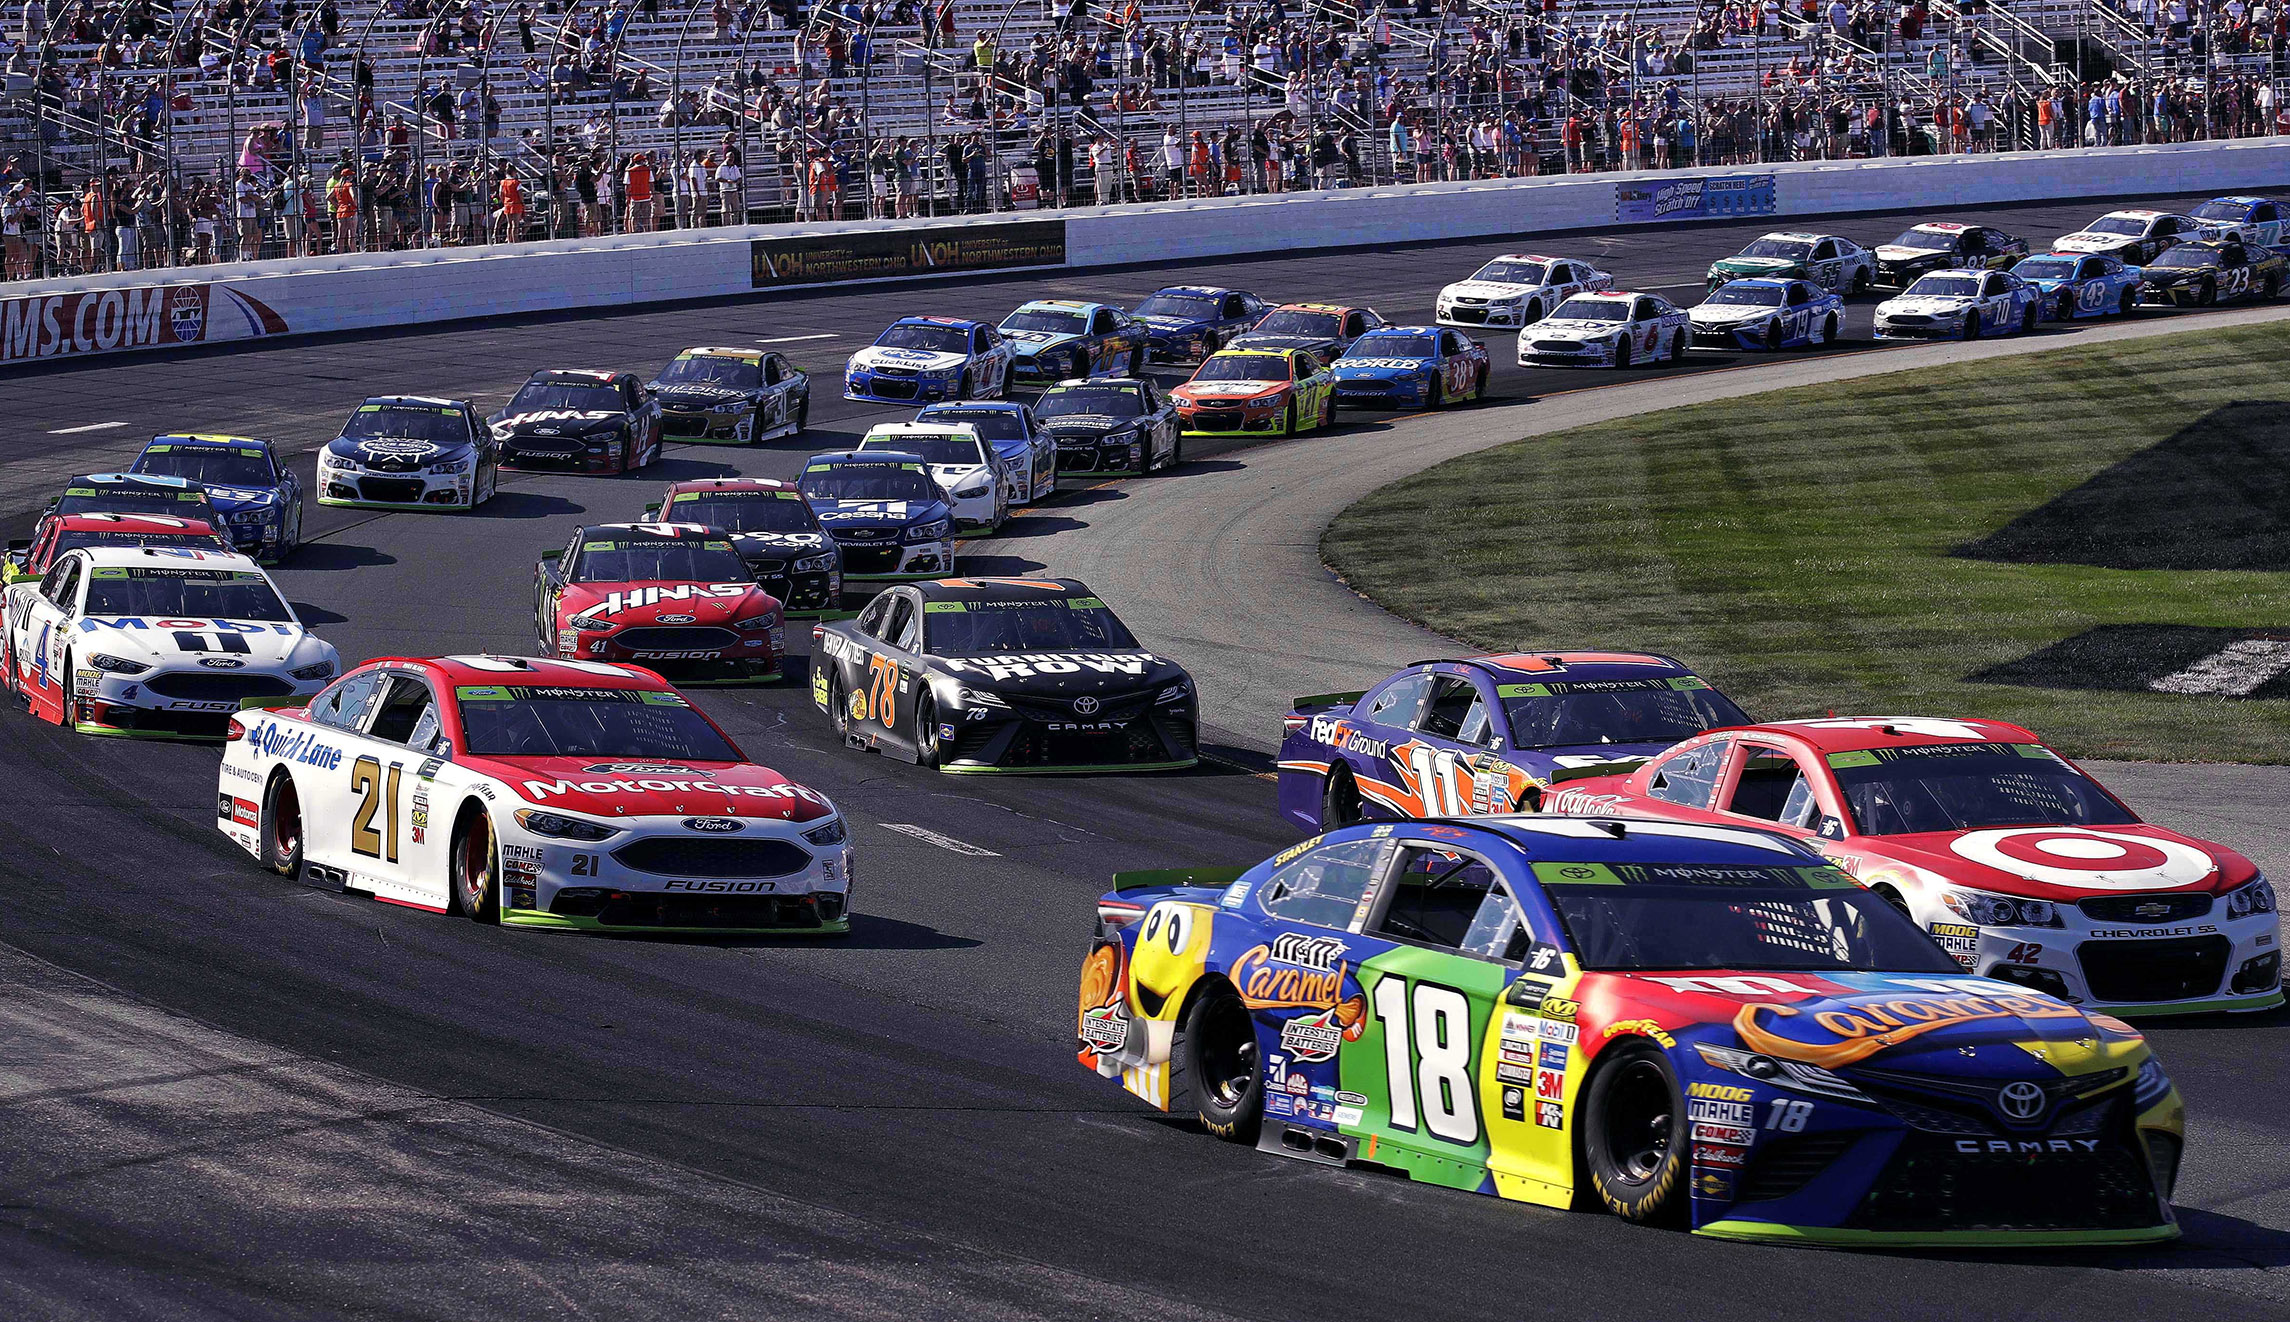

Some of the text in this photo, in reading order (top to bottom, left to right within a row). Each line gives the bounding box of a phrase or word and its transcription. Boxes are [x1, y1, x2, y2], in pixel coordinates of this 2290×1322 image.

[1656, 181, 1703, 202] High Speed
[1709, 181, 1731, 191] SCRATCH
[1732, 180, 1745, 190] HERE
[1655, 195, 1701, 216] Scratch Off
[911, 239, 959, 266] UNOH
[961, 244, 1062, 262] NORTHWESTERN OHIO
[962, 239, 1000, 249] UNIVERSITY
[754, 250, 803, 278] UNOH
[806, 250, 846, 260] UNIVERSITY
[806, 257, 906, 275] NORTHWESTERN OHIO
[2229, 266, 2250, 295] 23
[2086, 281, 2106, 308] 43
[1994, 298, 2011, 326] 10
[1645, 323, 1658, 353] 6
[1451, 361, 1467, 392] 38
[818, 511, 908, 521] Cessna
[150, 569, 211, 577] MONSTER
[986, 600, 1048, 608] MONSTER
[78, 616, 293, 635] Mobi
[663, 614, 689, 623] Ford
[35, 619, 52, 691] 4
[590, 640, 608, 653] 41
[632, 651, 721, 660] FUSION
[206, 658, 238, 668] Ford
[987, 658, 1147, 682] ROW
[76, 678, 101, 688] MAHLE
[77, 670, 103, 678] MOOG
[121, 685, 139, 700] 4
[536, 688, 619, 699] MONSTER
[869, 652, 899, 728] 78
[1572, 680, 1648, 691] MONSTER
[966, 707, 988, 721] 78
[1048, 723, 1129, 731] CAMRY
[1310, 714, 1390, 760] FedEx Ground
[263, 722, 343, 771] Quick Lane
[1902, 744, 1987, 757] MONSTER
[221, 763, 232, 775] TIRE
[237, 768, 250, 781] AUTO
[1411, 744, 1461, 817] 11
[522, 778, 824, 804] Motorcraft
[351, 754, 404, 864] 21
[694, 818, 733, 831] Ford
[1821, 819, 1839, 837] 16
[412, 826, 425, 845] 3M
[503, 844, 544, 860] MAHLE
[1273, 834, 1324, 868] STANLEY
[505, 859, 533, 872] COMP
[571, 854, 600, 877] 21
[1654, 866, 1770, 881] MONSTER
[504, 873, 536, 887] Edelbrock
[664, 881, 777, 892] FUSION
[1931, 923, 1979, 938] MOOG
[2090, 925, 2219, 938] CHEVROLET SS
[1530, 946, 1556, 970] 16
[2007, 943, 2043, 965] 42
[1230, 944, 1348, 1008] Caramel
[1085, 1015, 1126, 1034] INTERSTATE
[1538, 1020, 1565, 1037] Mobil
[1733, 994, 2078, 1067] Caramel
[1085, 1028, 1123, 1045] BATTERIES
[1285, 1024, 1339, 1044] INTERSTATE
[1603, 1018, 1677, 1050] GOODYEAR
[1285, 1035, 1337, 1054] BATTERIES
[1374, 971, 1479, 1147] 18
[1538, 1071, 1564, 1100] 3M
[1685, 1082, 1755, 1102] MOOG
[1691, 1100, 1752, 1122] MAHLE
[1765, 1098, 1815, 1133] 18
[1695, 1124, 1738, 1139] COMP
[1957, 1138, 2099, 1155] CAMRY
[1693, 1147, 1746, 1165] Edelbrock
